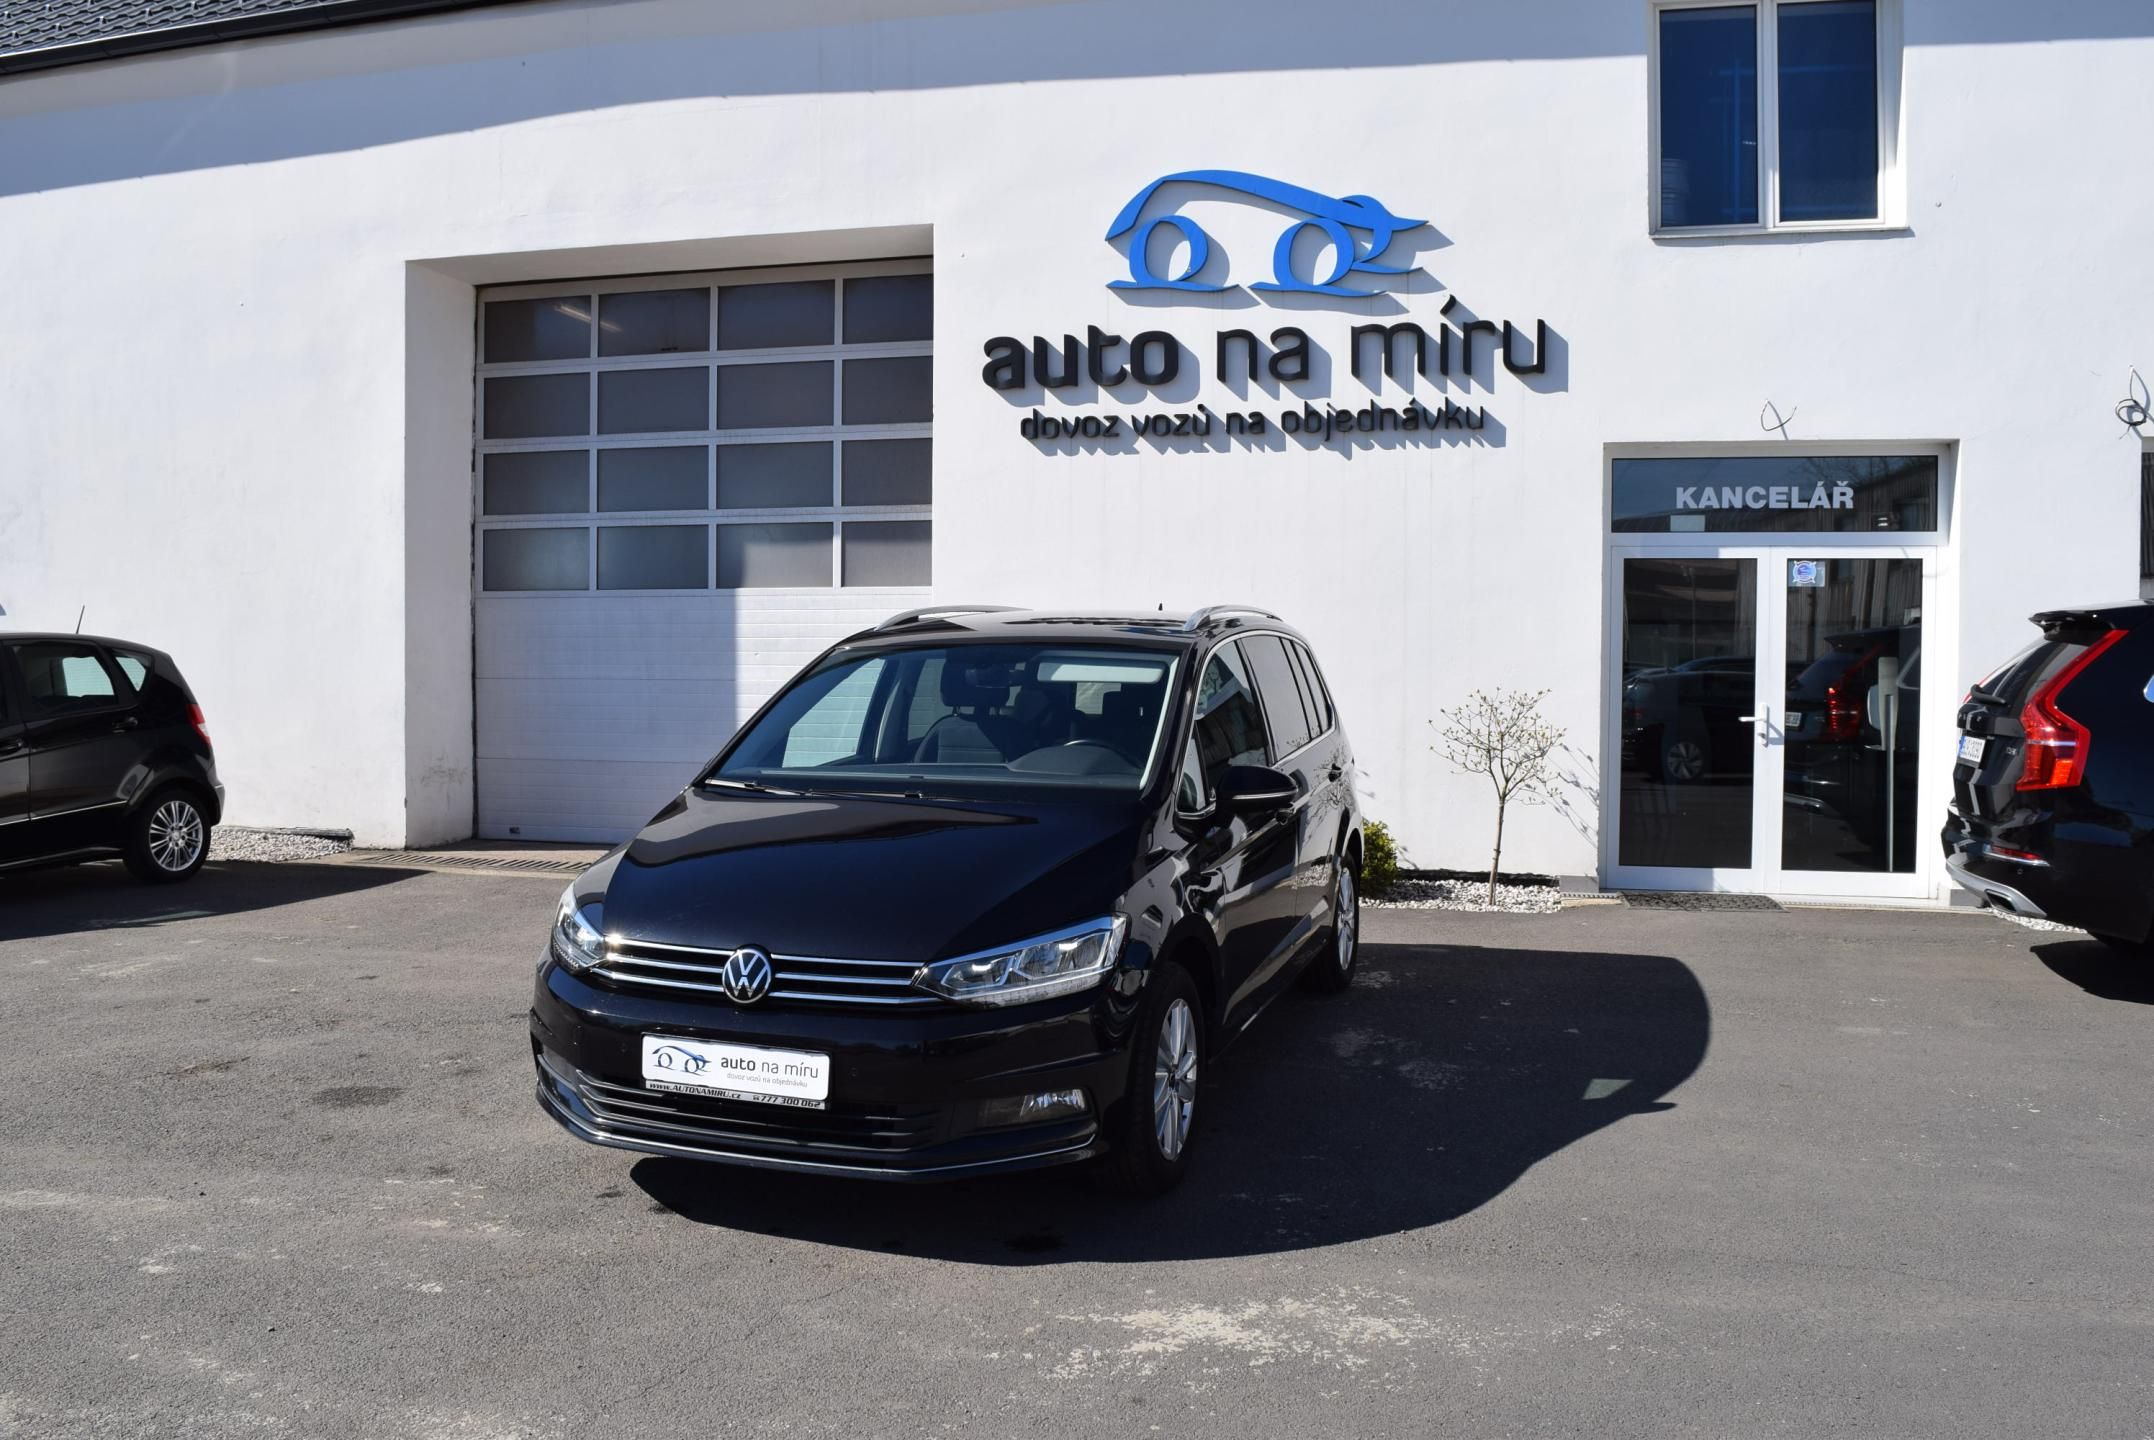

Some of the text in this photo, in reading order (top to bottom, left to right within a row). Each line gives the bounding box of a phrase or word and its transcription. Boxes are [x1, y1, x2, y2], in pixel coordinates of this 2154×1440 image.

[982, 294, 1546, 389] auto na míru
[1020, 397, 1484, 442] dovoz vozů na objednávku
[1676, 480, 1855, 509] KANCELÁŘ
[720, 1057, 819, 1079] auto na míru
